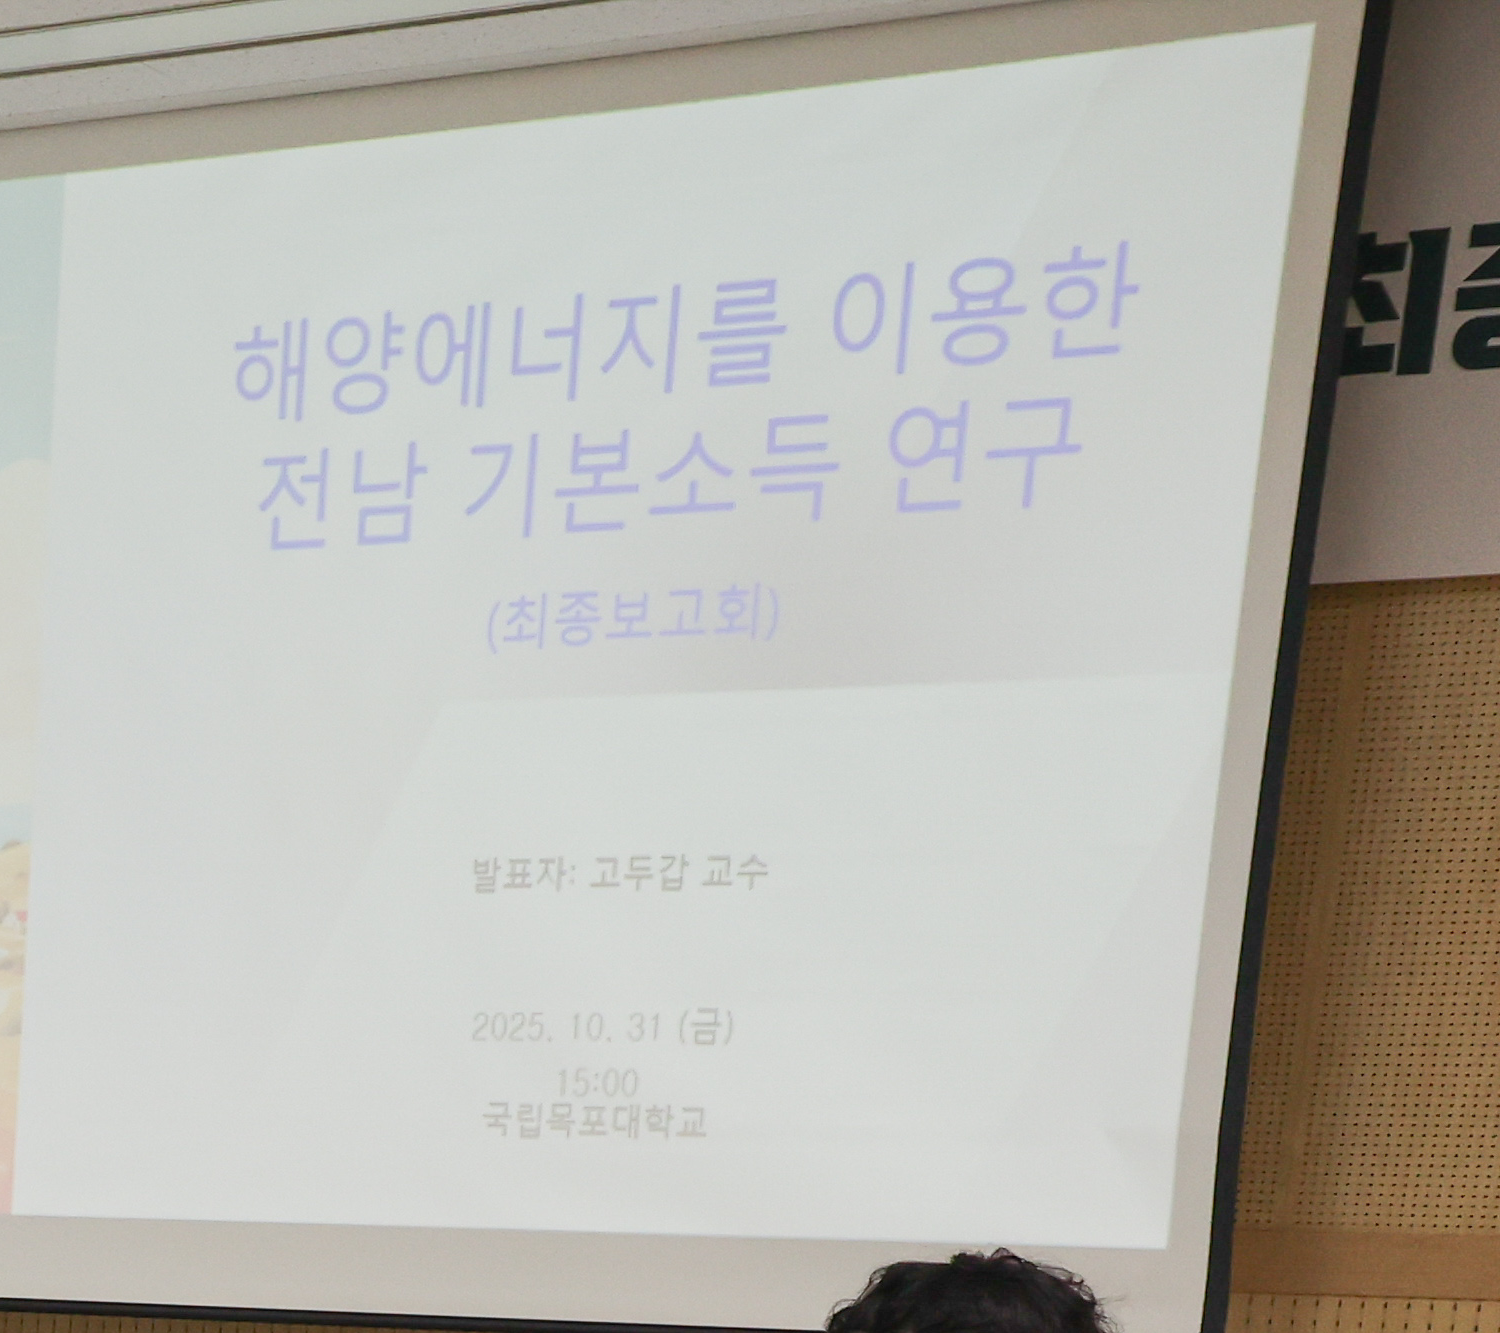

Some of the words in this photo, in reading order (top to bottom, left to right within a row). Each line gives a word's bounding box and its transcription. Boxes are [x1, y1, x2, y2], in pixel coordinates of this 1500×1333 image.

[233, 279, 788, 422] 해양에너지를
[831, 240, 1139, 374] 이용한
[257, 440, 427, 551] 전남
[464, 412, 840, 537] 기본소득
[887, 395, 1081, 513] 연구
[486, 583, 781, 654] (최종보고회)
[472, 856, 577, 894] 발표자:
[590, 853, 690, 892] 고두갑
[702, 853, 770, 890] 교수
[472, 1011, 553, 1043] 2025.
[571, 1010, 612, 1043] 10.
[628, 1010, 661, 1042] 31
[679, 1007, 735, 1046] (금)
[557, 1067, 639, 1098] 15:00
[482, 1101, 708, 1140] 국립목포대학교
